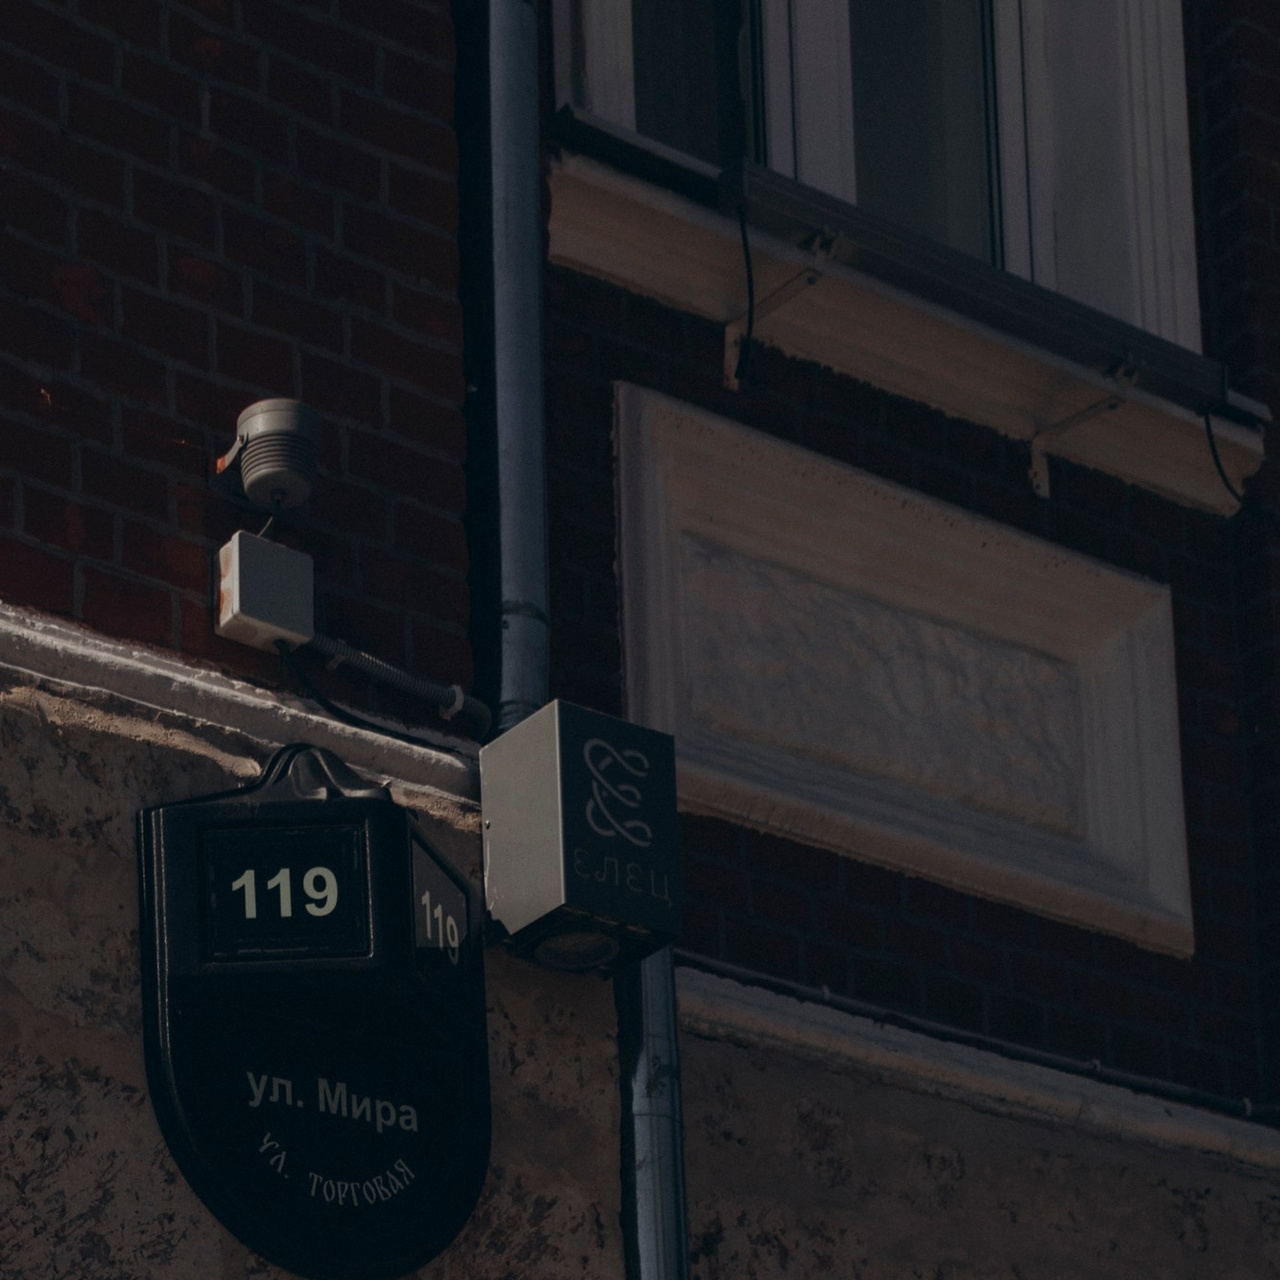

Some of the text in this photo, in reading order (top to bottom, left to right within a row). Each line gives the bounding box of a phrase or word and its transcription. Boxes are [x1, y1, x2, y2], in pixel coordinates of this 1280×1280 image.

[230, 866, 339, 920] 119
[572, 847, 672, 909] ЕЛЕЦ
[420, 889, 460, 966] 119
[246, 1070, 419, 1134] ул. Мира
[308, 1158, 416, 1207] ТОРГОВАЯ
